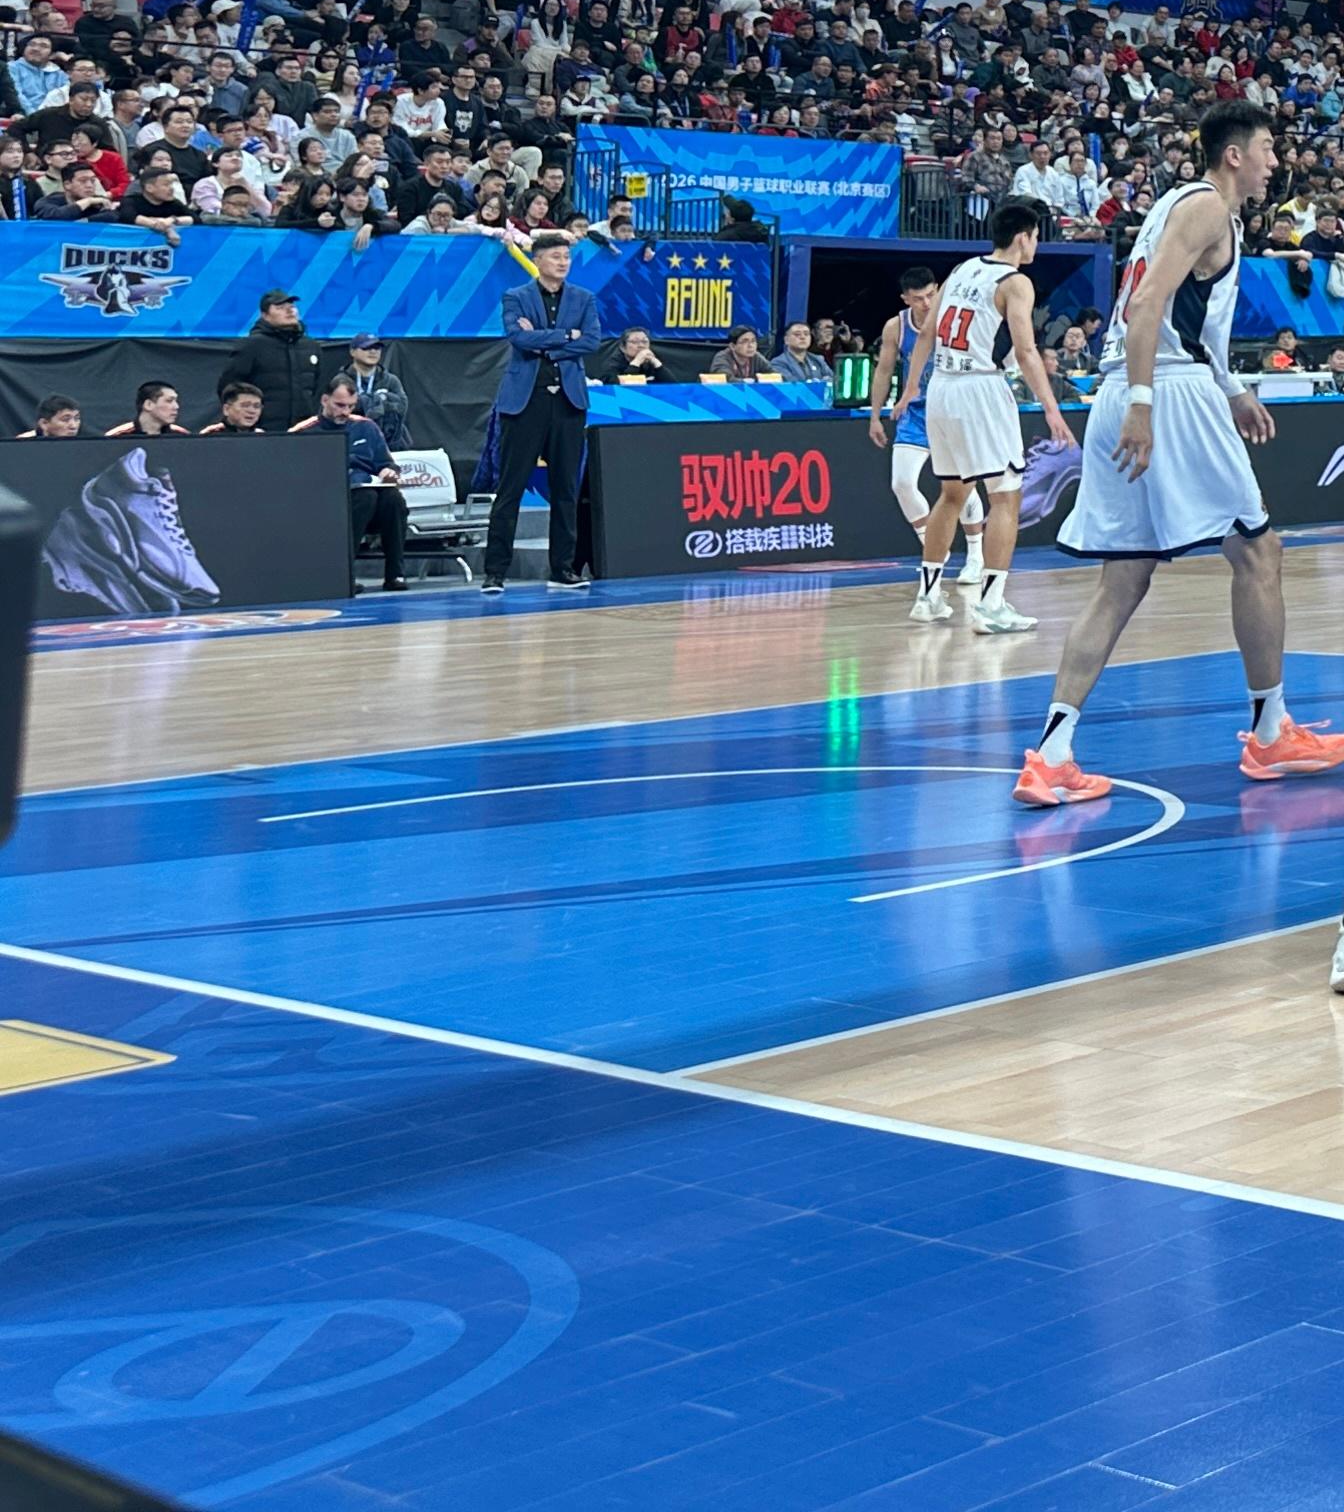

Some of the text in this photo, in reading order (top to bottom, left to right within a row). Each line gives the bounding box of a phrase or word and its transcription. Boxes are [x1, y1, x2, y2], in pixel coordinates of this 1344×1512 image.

[63, 245, 171, 271] DUCKS
[665, 278, 733, 328] BEIJING
[938, 305, 975, 352] 41
[680, 448, 832, 523] 驭帅20
